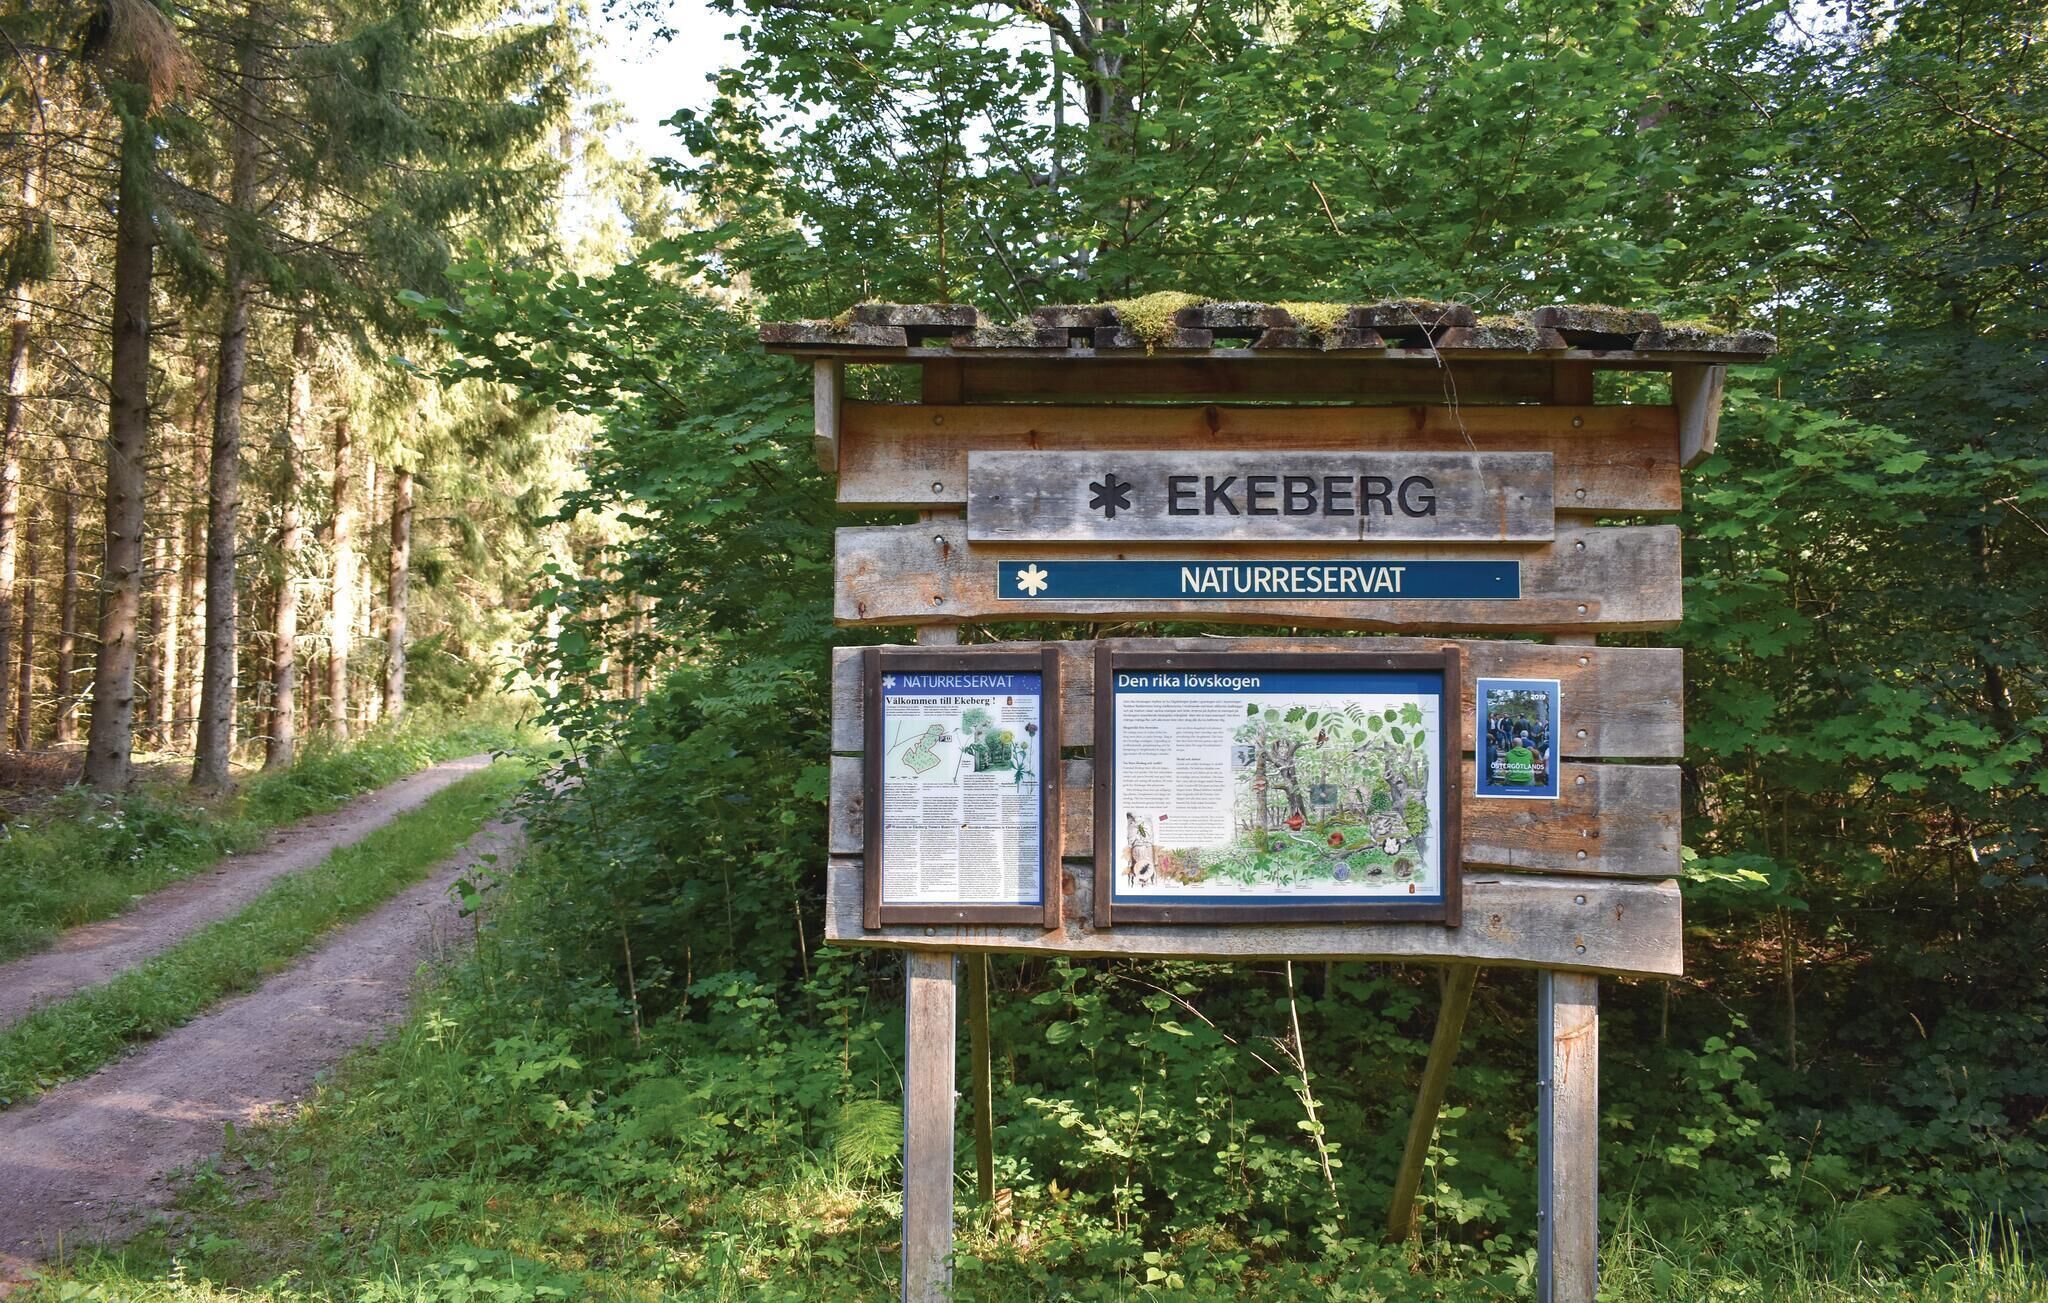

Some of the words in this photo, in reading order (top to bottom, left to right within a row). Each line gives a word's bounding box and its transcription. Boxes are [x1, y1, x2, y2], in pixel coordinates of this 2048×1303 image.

[1168, 475, 1437, 517] EKEBERG
[1181, 566, 1406, 594] NATURRESERVAT
[903, 675, 1014, 688] NATURRESERVAT
[1118, 674, 1148, 687] Den
[1152, 674, 1180, 687] rika
[1184, 674, 1261, 691] lövskogen
[886, 696, 938, 705] Välkommen
[939, 696, 952, 705] till
[954, 696, 990, 707] Ekeberg
[1490, 761, 1545, 770] ÖSTERGÖTLANDS
